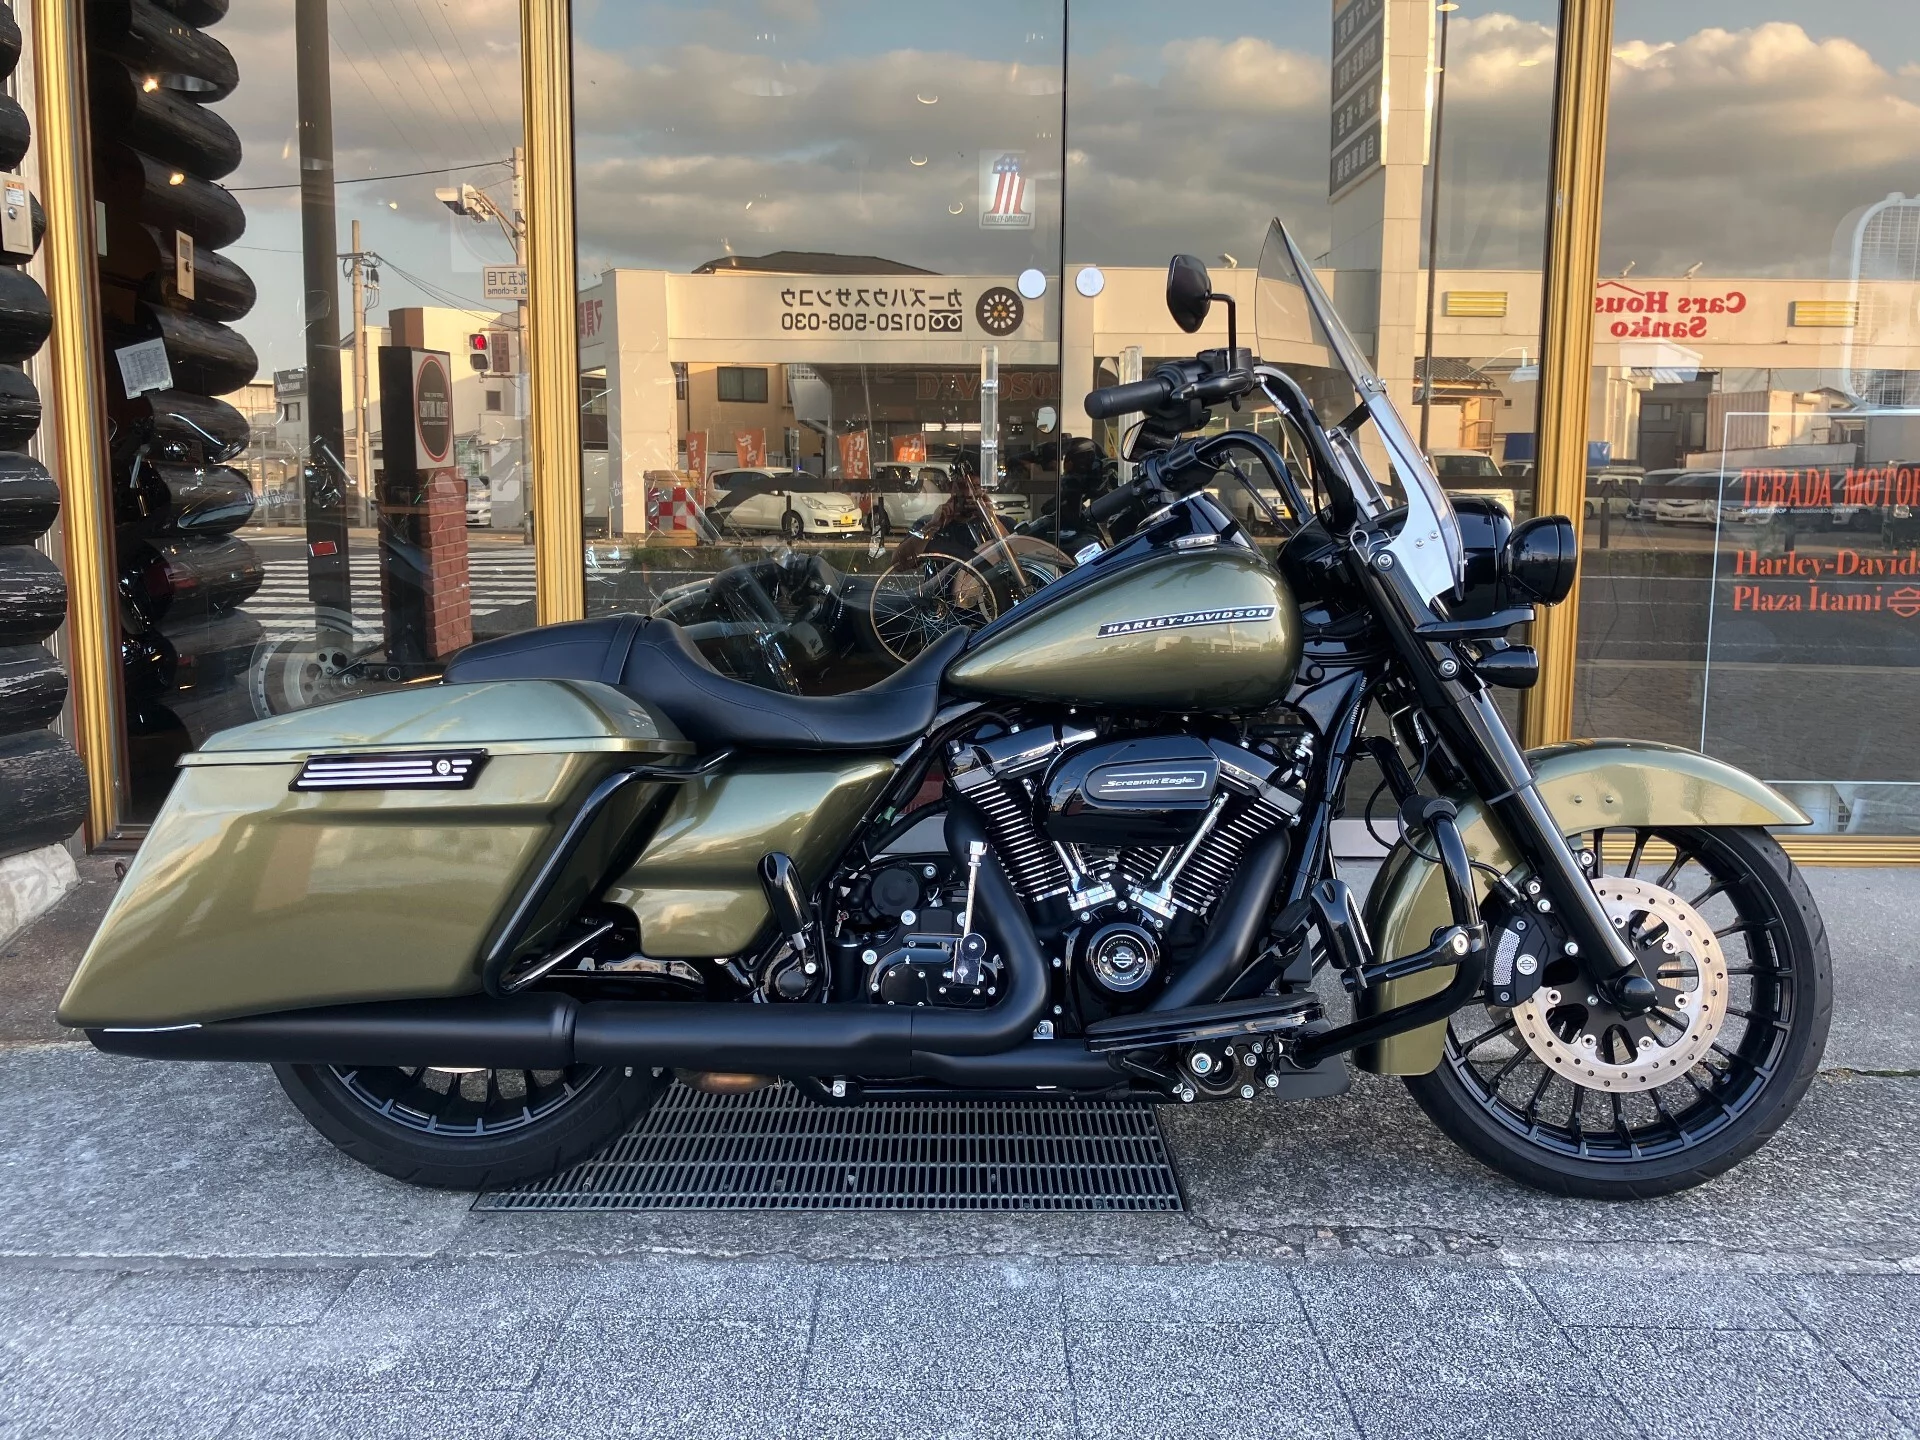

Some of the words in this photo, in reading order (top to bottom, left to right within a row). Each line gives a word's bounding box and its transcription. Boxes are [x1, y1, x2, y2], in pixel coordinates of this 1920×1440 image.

[915, 371, 1060, 400] DAVDSO
[1740, 468, 1833, 507] TERADA
[1734, 549, 1920, 577] Harley-David
[1733, 585, 1802, 612] Plaza
[1107, 608, 1269, 634] HARLEY-DAVIDSON
